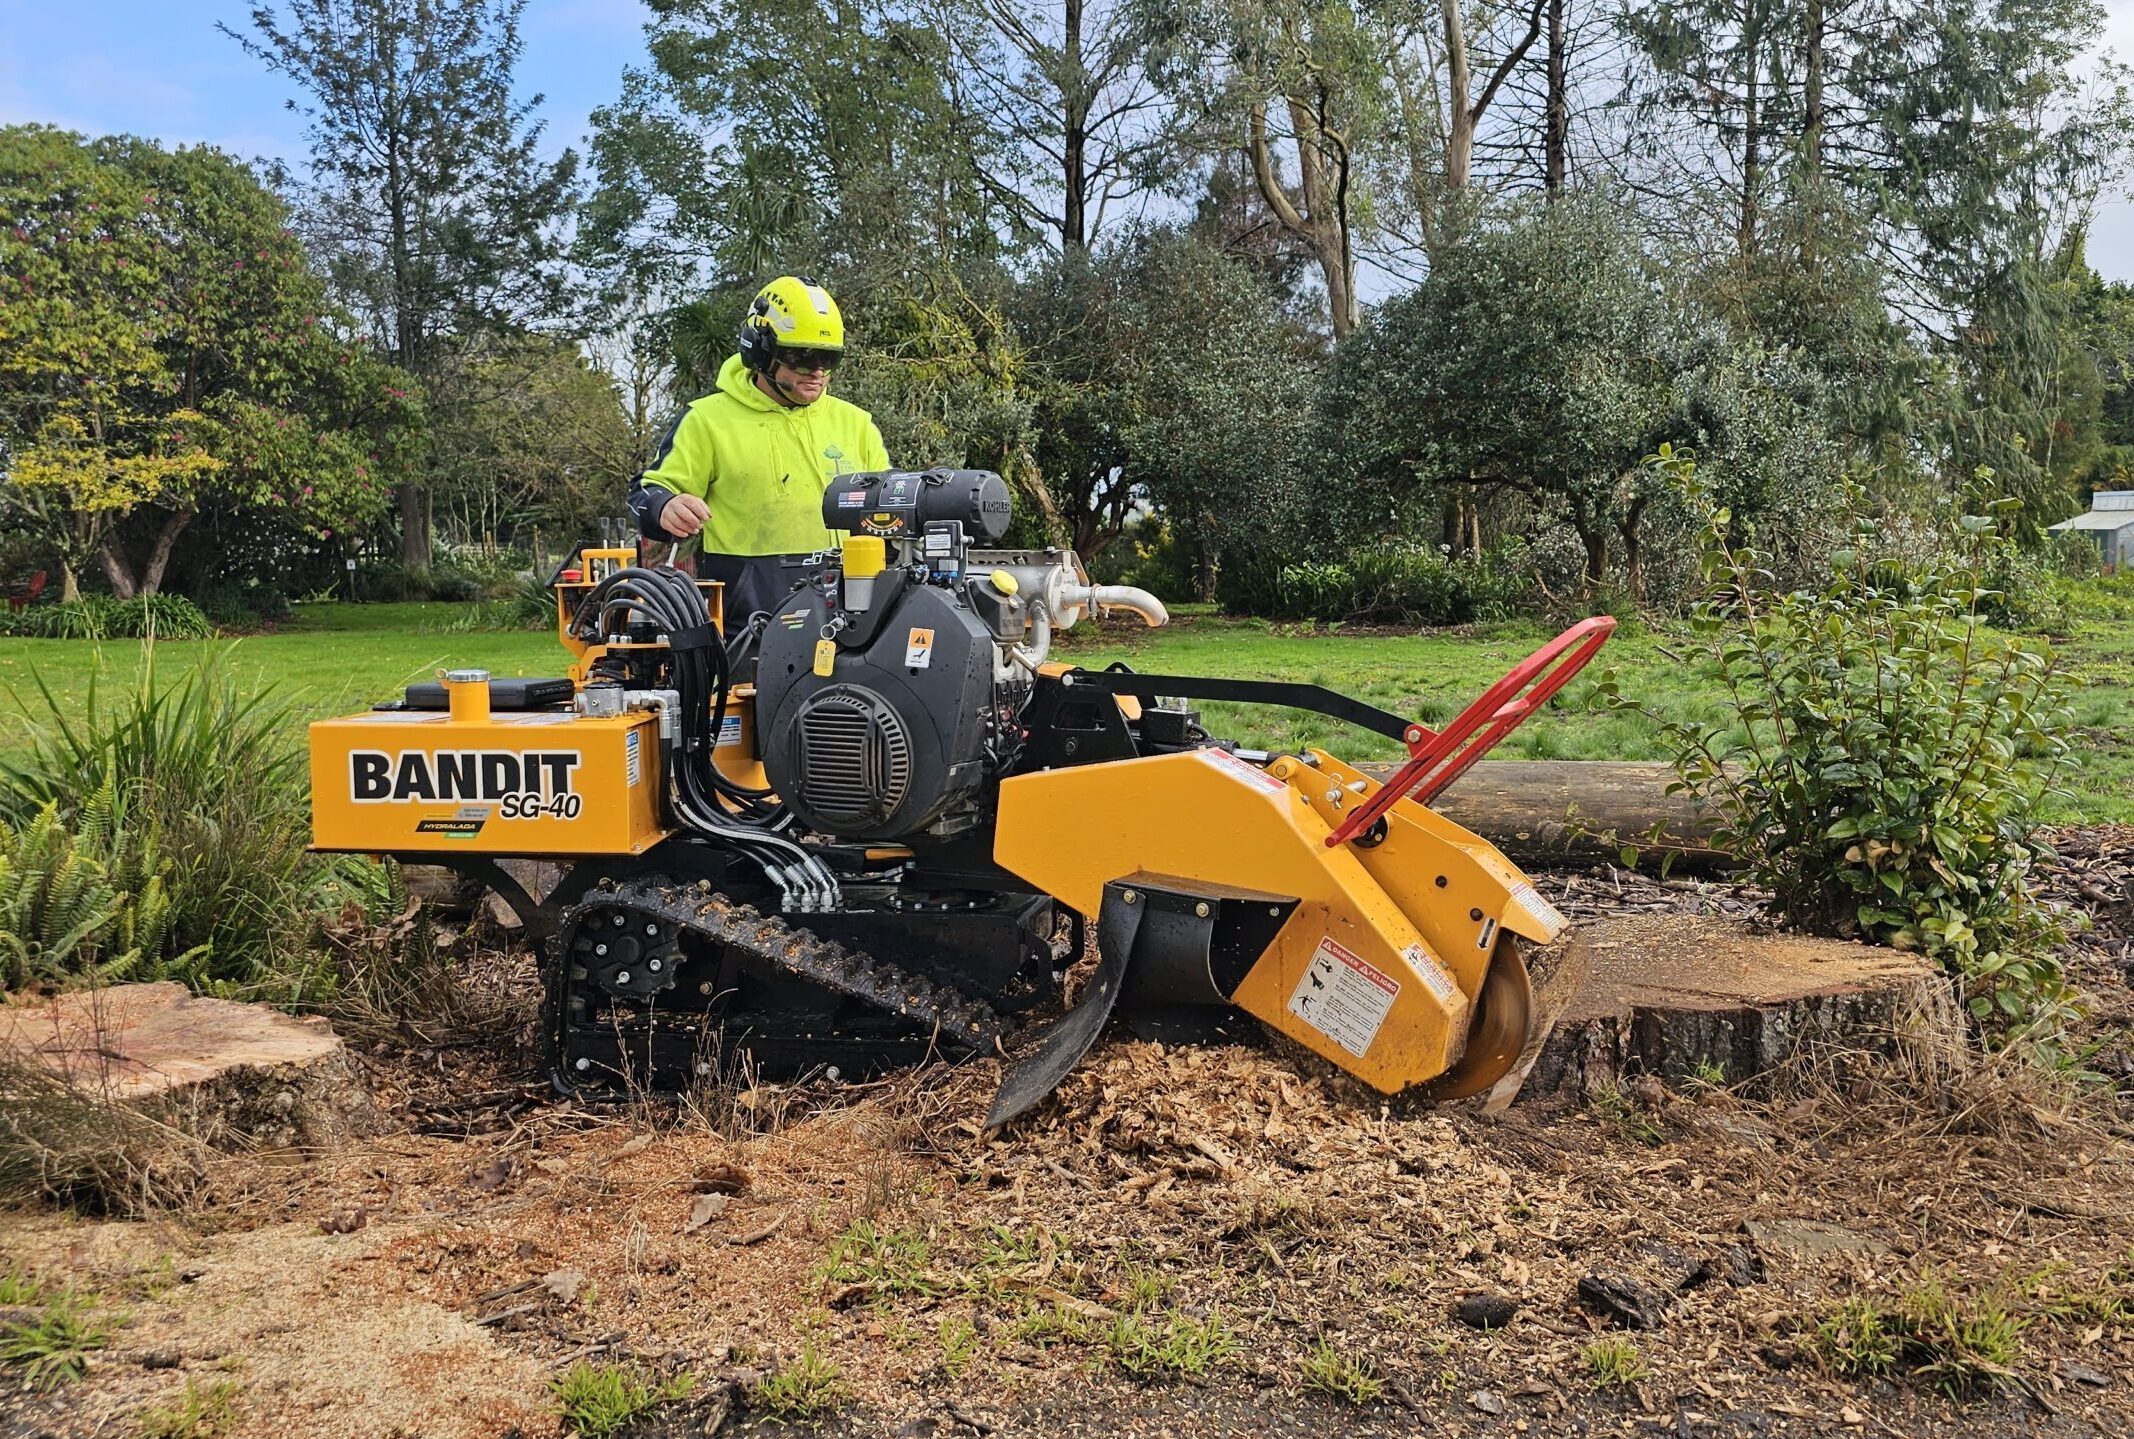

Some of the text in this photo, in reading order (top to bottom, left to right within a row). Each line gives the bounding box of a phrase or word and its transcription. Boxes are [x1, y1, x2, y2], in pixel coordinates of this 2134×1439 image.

[984, 500, 1010, 513] KOHLER
[351, 752, 579, 801] BANDIT
[500, 794, 582, 819] SG-40
[1332, 946, 1360, 967] DANGER
[1367, 970, 1397, 993] PELIGRO
